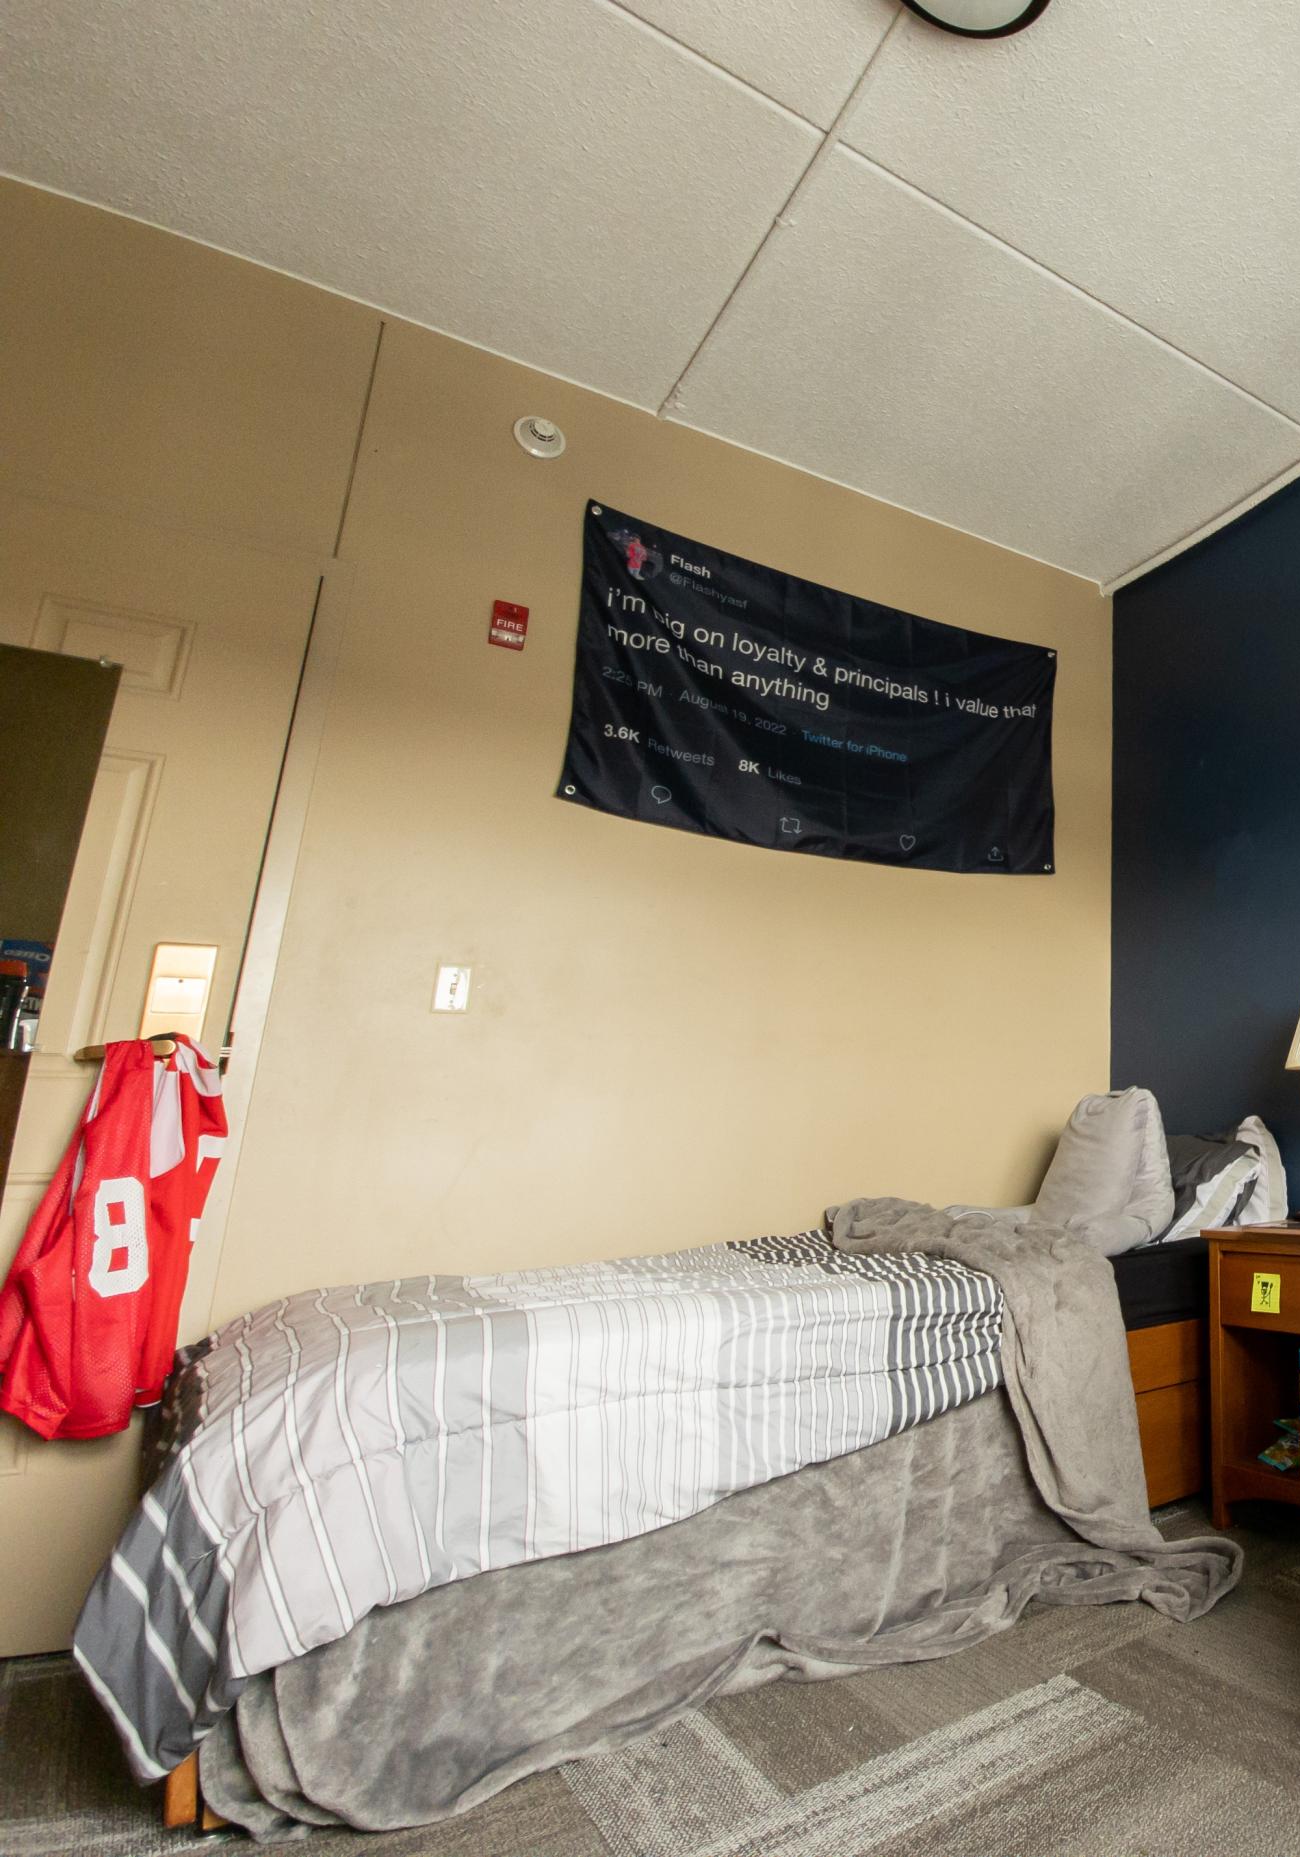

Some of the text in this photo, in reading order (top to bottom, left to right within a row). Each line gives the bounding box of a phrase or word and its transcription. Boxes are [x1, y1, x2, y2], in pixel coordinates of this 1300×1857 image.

[670, 554, 711, 579] Flash
[496, 618, 524, 632] FIRE
[607, 587, 646, 614] i'm
[694, 628, 725, 648] on
[732, 633, 806, 672] loyalty
[813, 657, 828, 677] &
[834, 667, 929, 703] principals
[945, 693, 950, 707] i
[956, 698, 999, 718] value
[1002, 704, 1037, 719] that
[607, 624, 830, 710] more than anything
[604, 724, 802, 785] 3.6K Retweets 8K Likes
[637, 681, 663, 698] PM
[755, 717, 787, 735] 2022
[802, 729, 843, 749] Twitter
[847, 740, 865, 753] for
[865, 745, 908, 763] iPhone
[87, 1176, 149, 1298] 8
